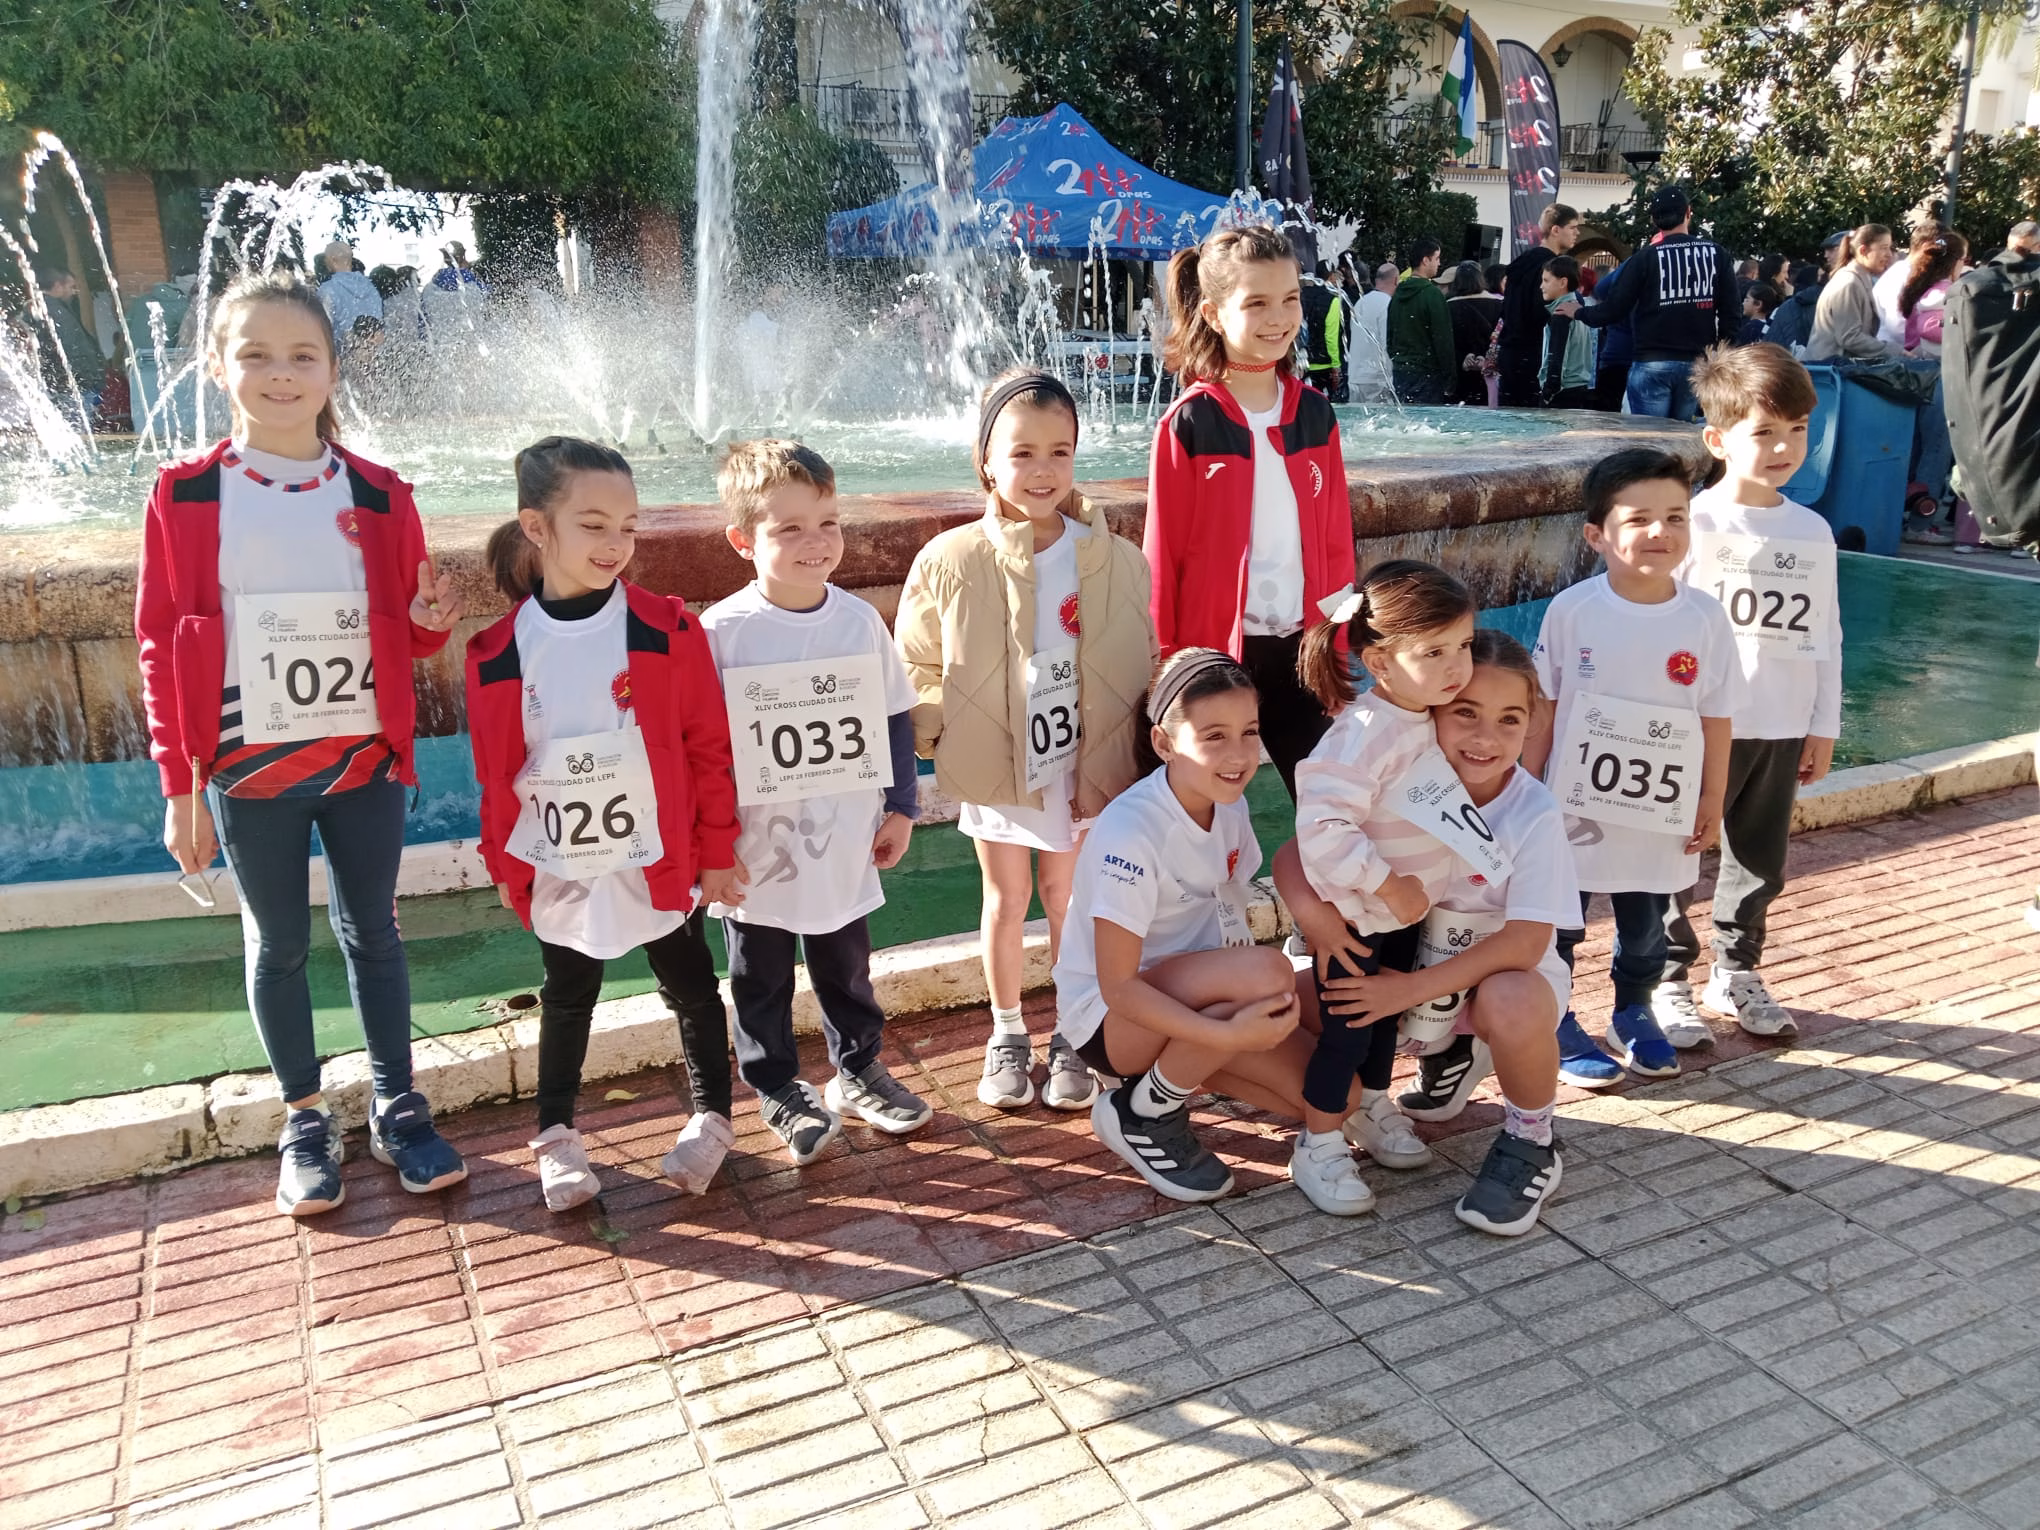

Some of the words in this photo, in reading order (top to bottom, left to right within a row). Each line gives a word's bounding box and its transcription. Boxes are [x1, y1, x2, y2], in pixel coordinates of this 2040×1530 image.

[1657, 246, 1717, 300] ELLESSE
[1713, 580, 1811, 632] 1022
[268, 634, 288, 643] XLIV
[290, 633, 317, 643] CROSS
[318, 632, 350, 642] CIUDAD
[754, 704, 772, 713] XLIV
[773, 701, 797, 711] CROSS
[798, 698, 826, 708] CIUDAD
[827, 696, 838, 704] DE
[838, 694, 855, 703] LEPE
[266, 722, 290, 732] Lepe
[1028, 700, 1081, 755] 03
[749, 716, 866, 769] 1033
[1588, 729, 1604, 738] XLIV
[1605, 733, 1628, 743] CROSS
[1629, 737, 1657, 747] CIUDAD
[585, 775, 596, 784] DE
[597, 772, 617, 782] LEPE
[858, 769, 879, 780] Lepe
[1578, 741, 1684, 804] 1035
[756, 784, 778, 794] Lepe
[1566, 797, 1585, 807] Lepe
[530, 793, 635, 848] 1026
[1441, 803, 1494, 842] 10
[1664, 816, 1683, 825] Lepe
[525, 850, 548, 863] Lepe
[628, 848, 650, 860] Lepe
[1104, 854, 1144, 877] ARTAYA
